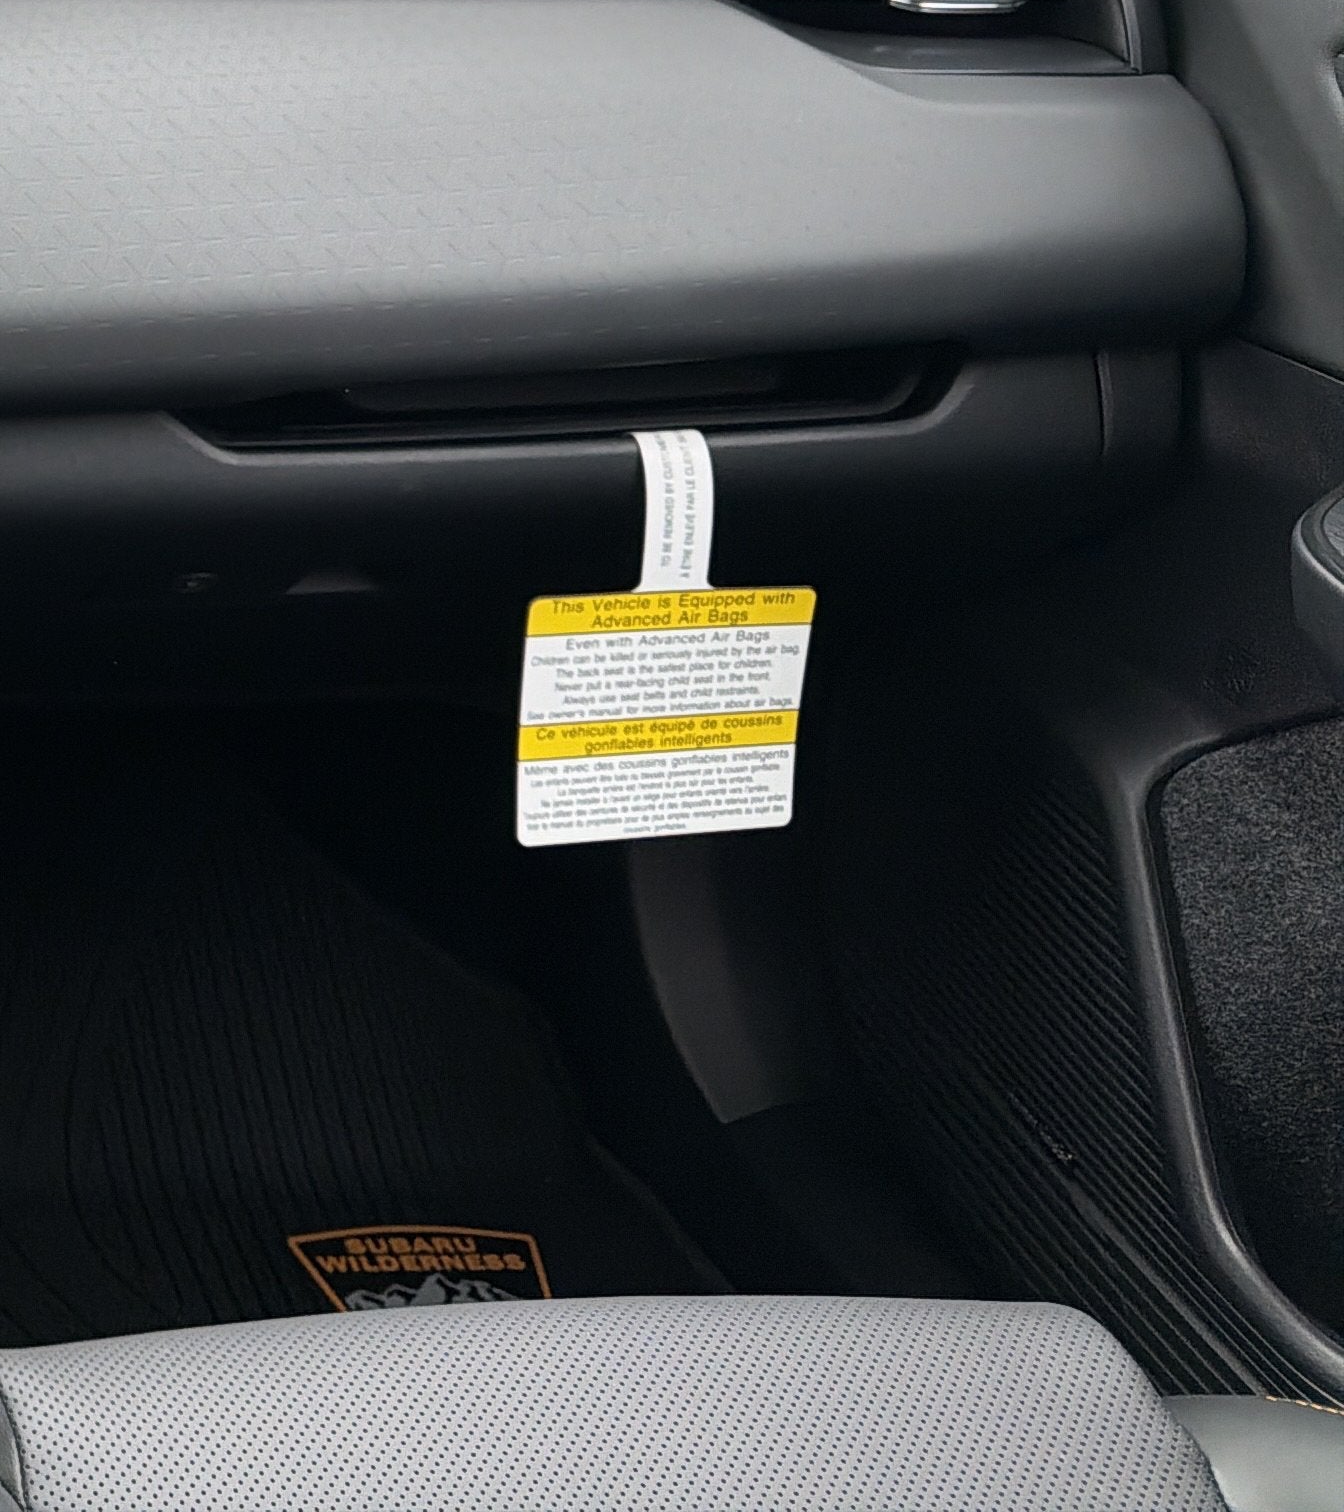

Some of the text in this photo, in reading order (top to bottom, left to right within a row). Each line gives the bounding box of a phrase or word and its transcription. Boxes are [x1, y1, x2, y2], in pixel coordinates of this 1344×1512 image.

[552, 592, 796, 614] This Vehicle is Equipped with
[591, 608, 749, 628] Advanced Air Bags
[566, 630, 770, 651] Even with Advanced Air Bags
[536, 727, 556, 741] Ce
[623, 723, 644, 735] est
[649, 720, 696, 735] équipé
[700, 718, 718, 730] de
[723, 714, 783, 728] coussins
[584, 731, 732, 754] gonflables intelligents
[593, 761, 614, 771] des
[732, 749, 790, 762] intelligents
[344, 1238, 476, 1254] SUBARU
[315, 1253, 527, 1273] WILDERNESS
